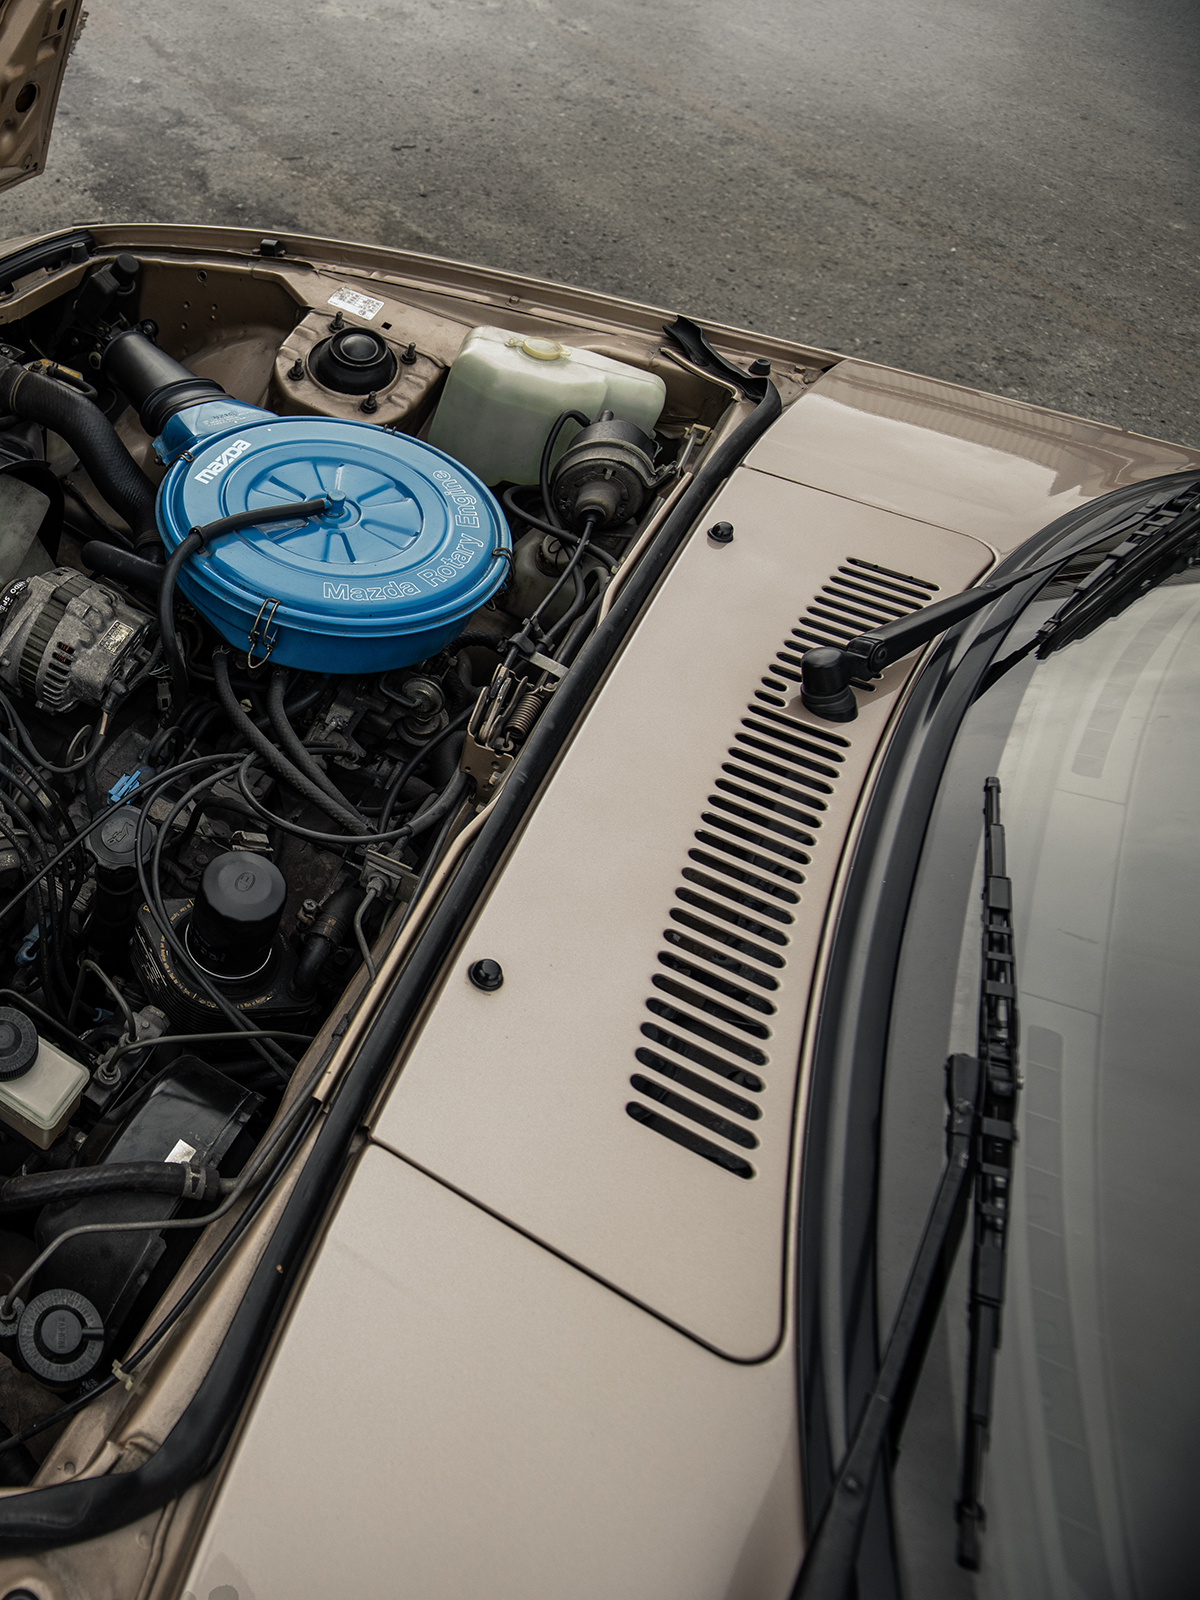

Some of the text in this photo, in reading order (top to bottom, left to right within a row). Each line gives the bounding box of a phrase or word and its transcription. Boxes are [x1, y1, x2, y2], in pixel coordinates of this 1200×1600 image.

[323, 469, 484, 601] Mazda Rotary Engine
